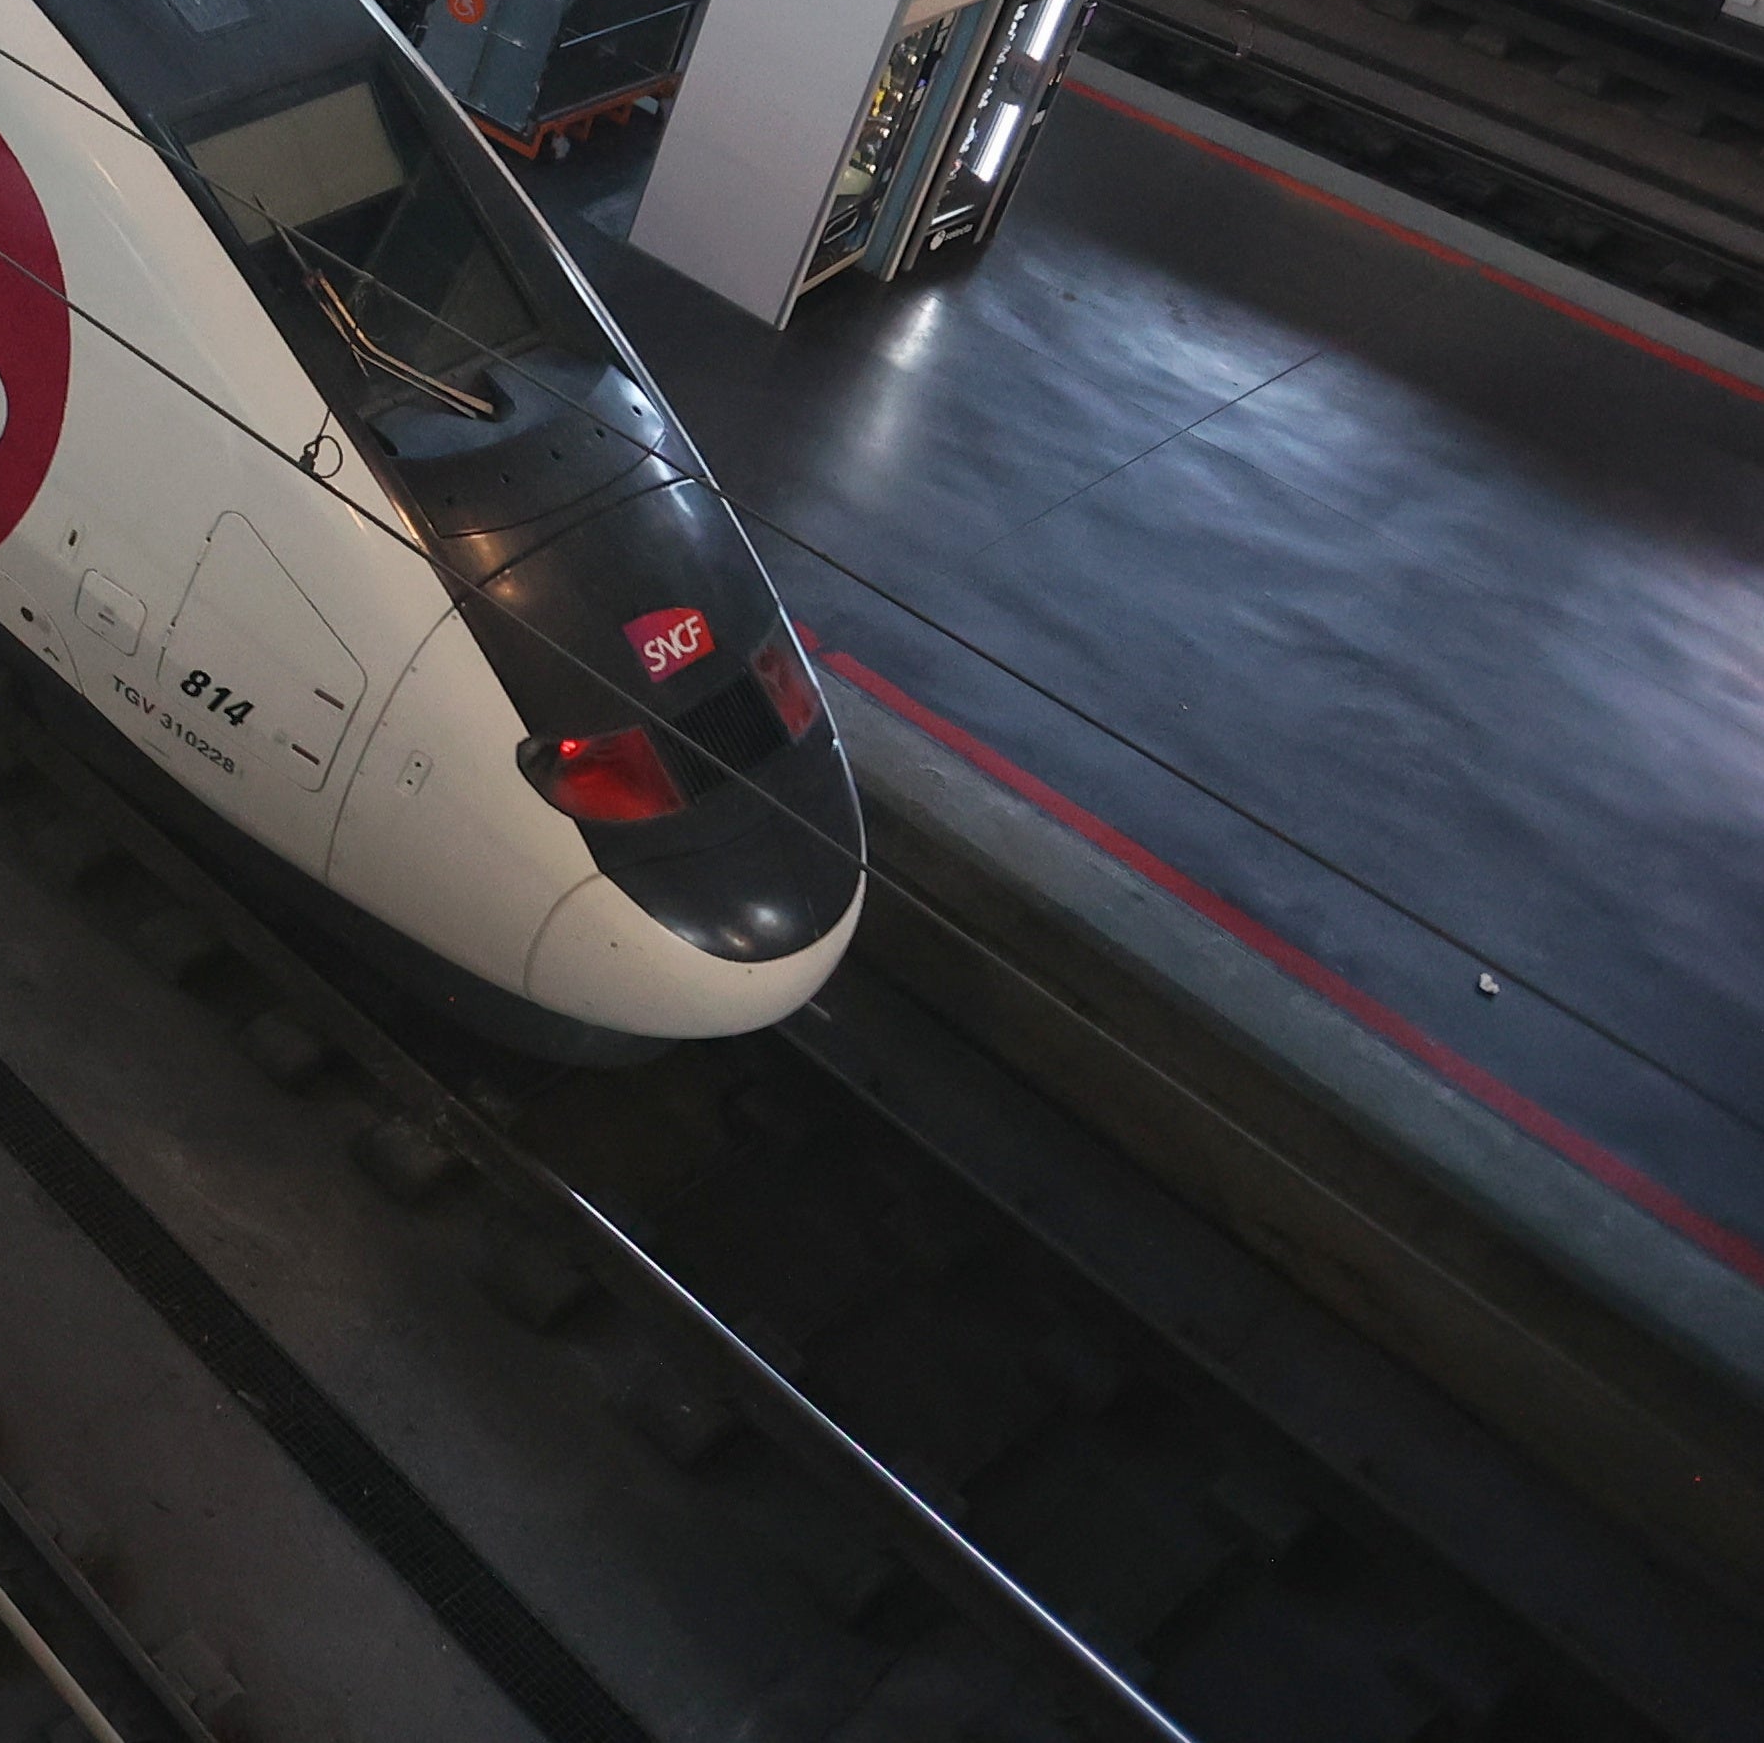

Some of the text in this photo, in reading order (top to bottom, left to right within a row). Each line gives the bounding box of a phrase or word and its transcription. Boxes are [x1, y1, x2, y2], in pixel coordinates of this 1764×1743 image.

[643, 615, 702, 673] SNCF
[112, 674, 237, 775] TGV 310228
[180, 669, 256, 728] 814
